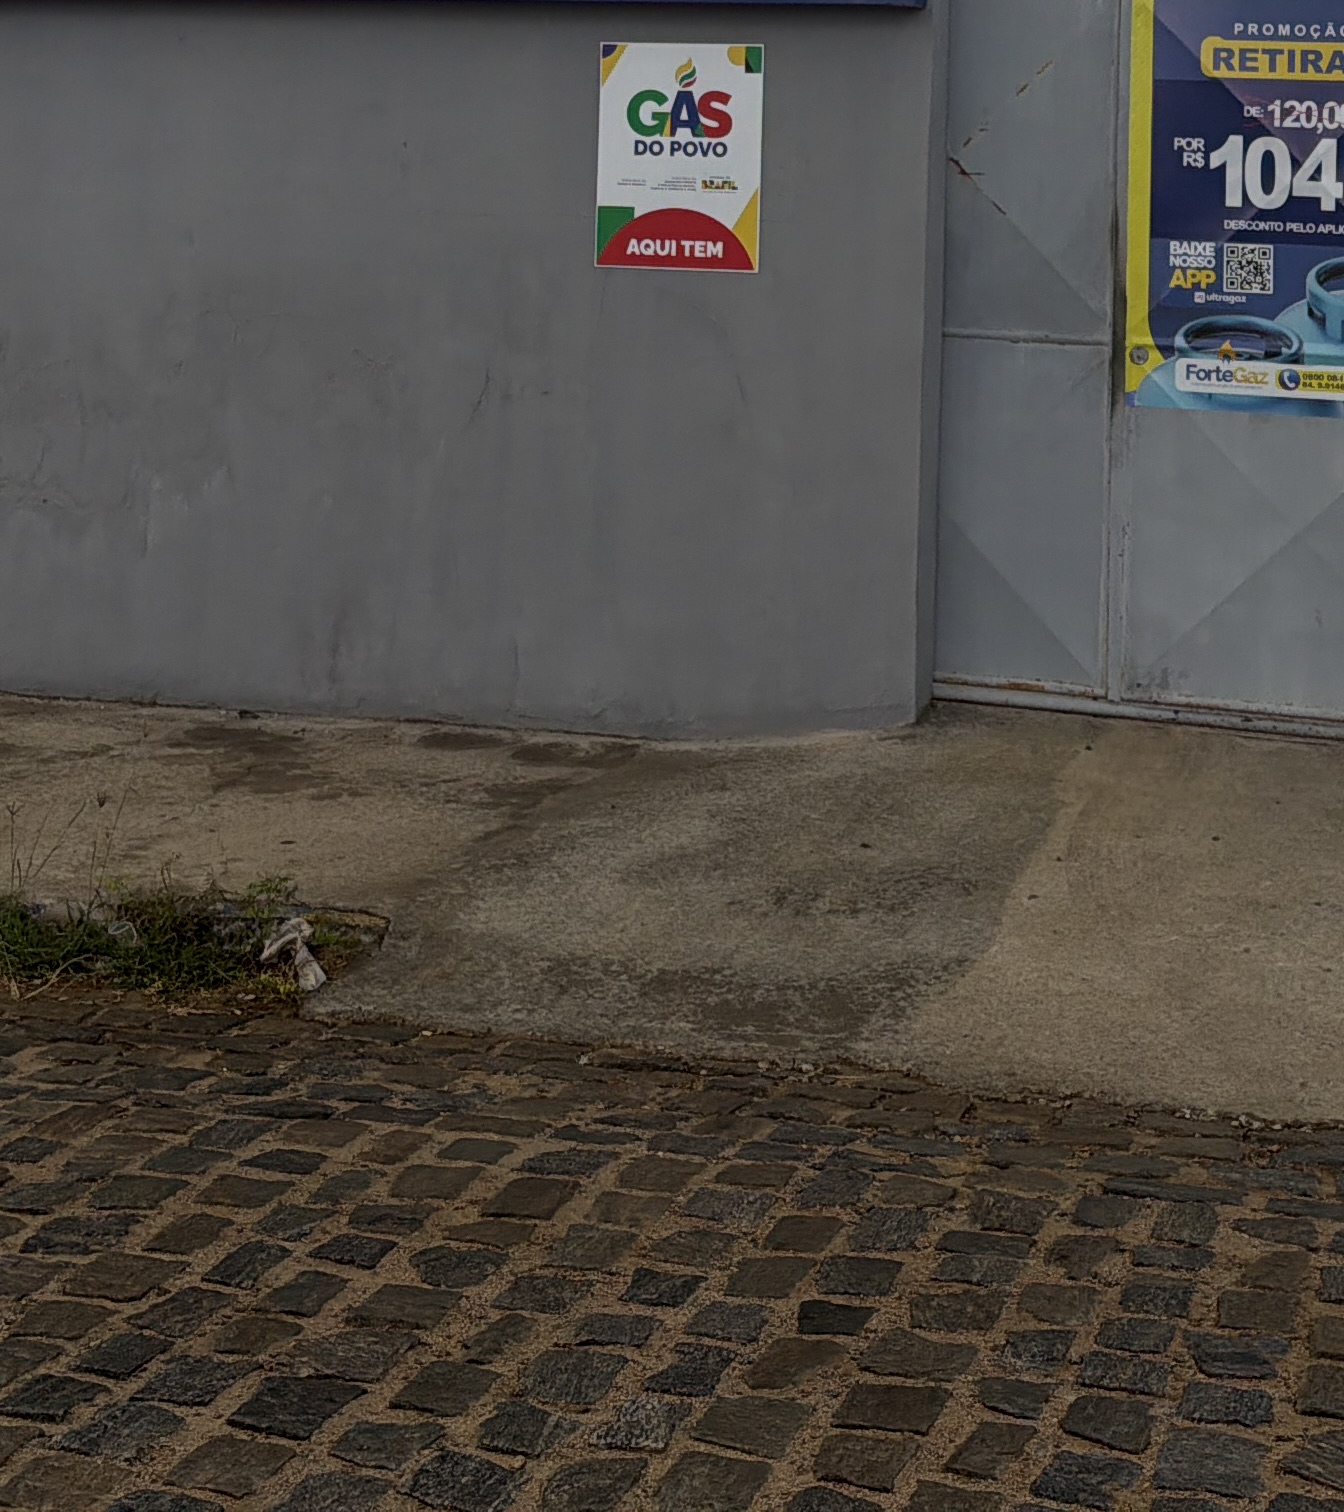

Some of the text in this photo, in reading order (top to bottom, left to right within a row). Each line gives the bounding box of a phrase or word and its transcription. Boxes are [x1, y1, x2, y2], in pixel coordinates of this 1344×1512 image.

[1243, 105, 1265, 119] DE:
[633, 140, 728, 158] DO POVO
[1173, 137, 1205, 151] POR
[1182, 152, 1205, 168] R$
[1224, 219, 1284, 233] DESCONTO
[1286, 221, 1316, 234] PELO
[626, 238, 724, 259] AQUI TEM
[1169, 241, 1216, 256] BAIXE
[1169, 256, 1216, 268] NOSSO
[1169, 268, 1217, 290] APP
[1206, 293, 1247, 305] ultragaz
[1185, 363, 1269, 386] ForteGaz
